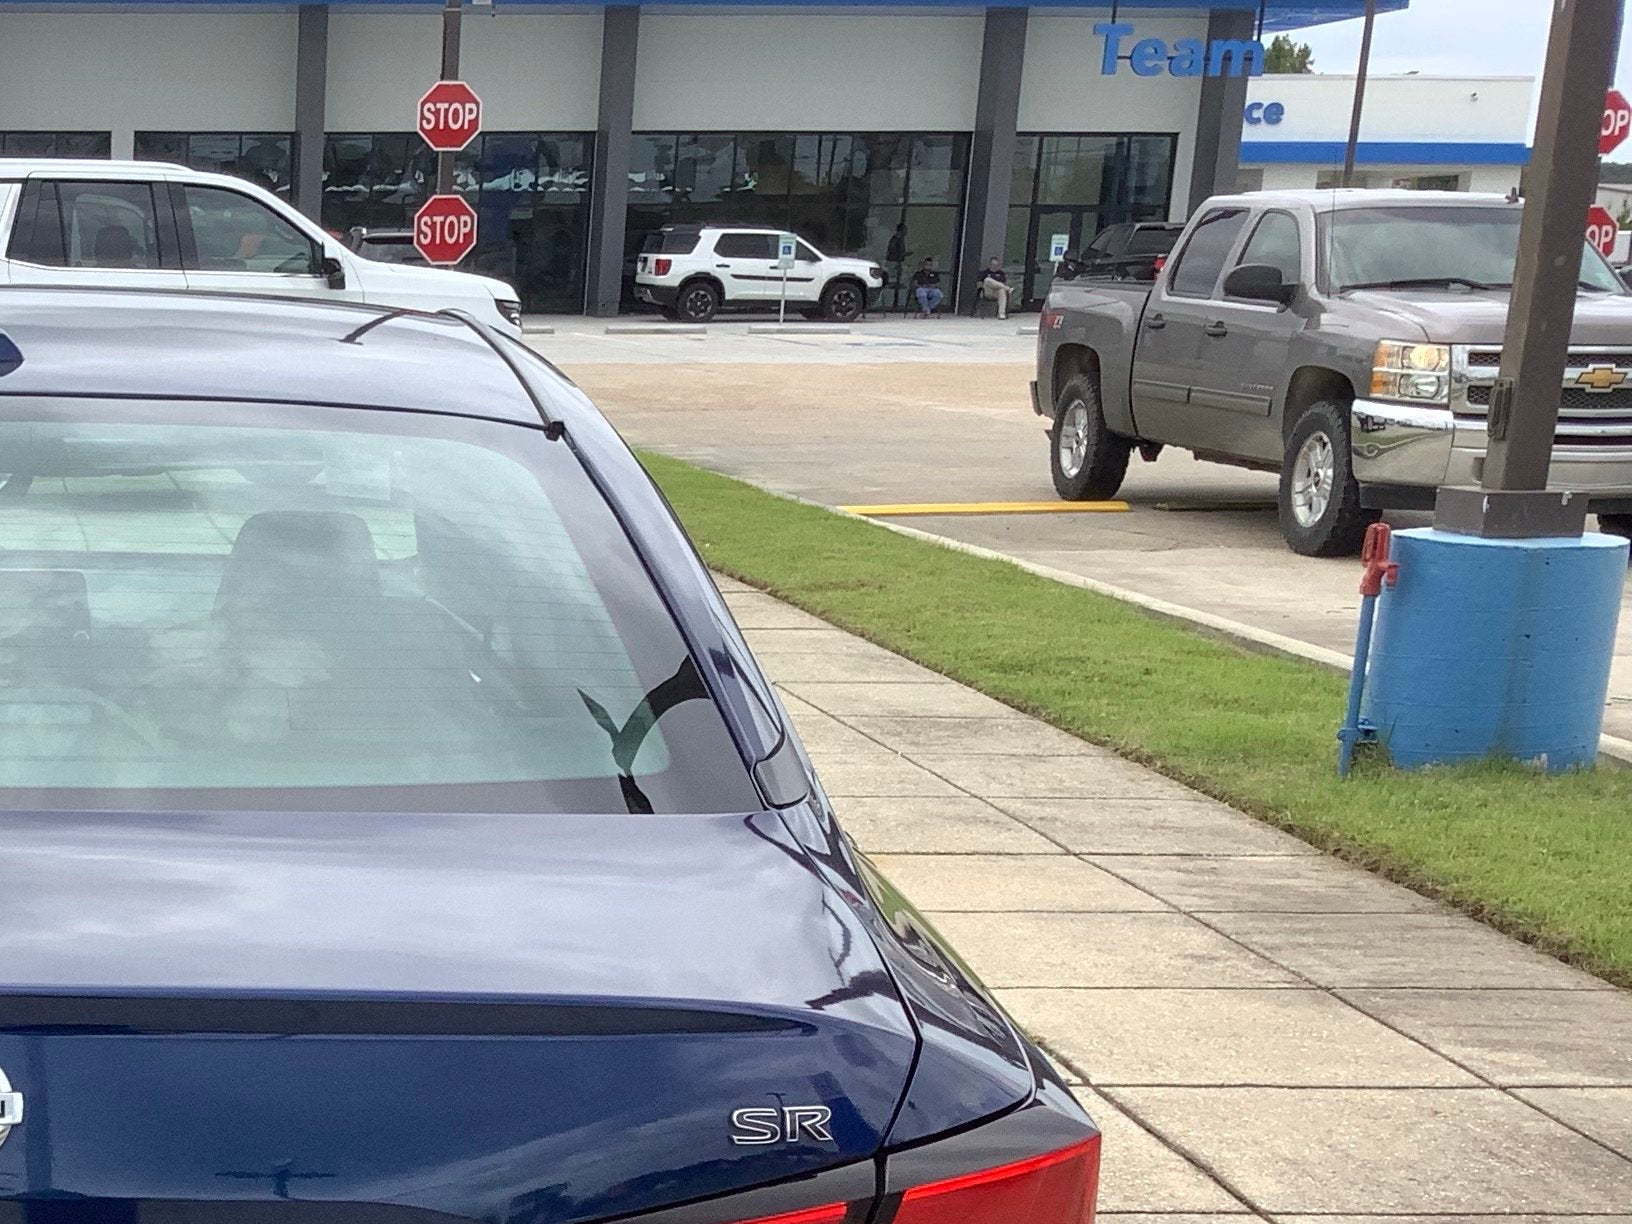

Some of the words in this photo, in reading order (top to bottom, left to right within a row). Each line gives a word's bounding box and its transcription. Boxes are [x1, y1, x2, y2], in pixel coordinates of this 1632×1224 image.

[1093, 22, 1266, 77] Team
[422, 102, 477, 130] STOP
[1601, 109, 1630, 136] OP
[419, 215, 471, 244] STOP
[1586, 225, 1614, 253] OP
[732, 1105, 833, 1144] SR
